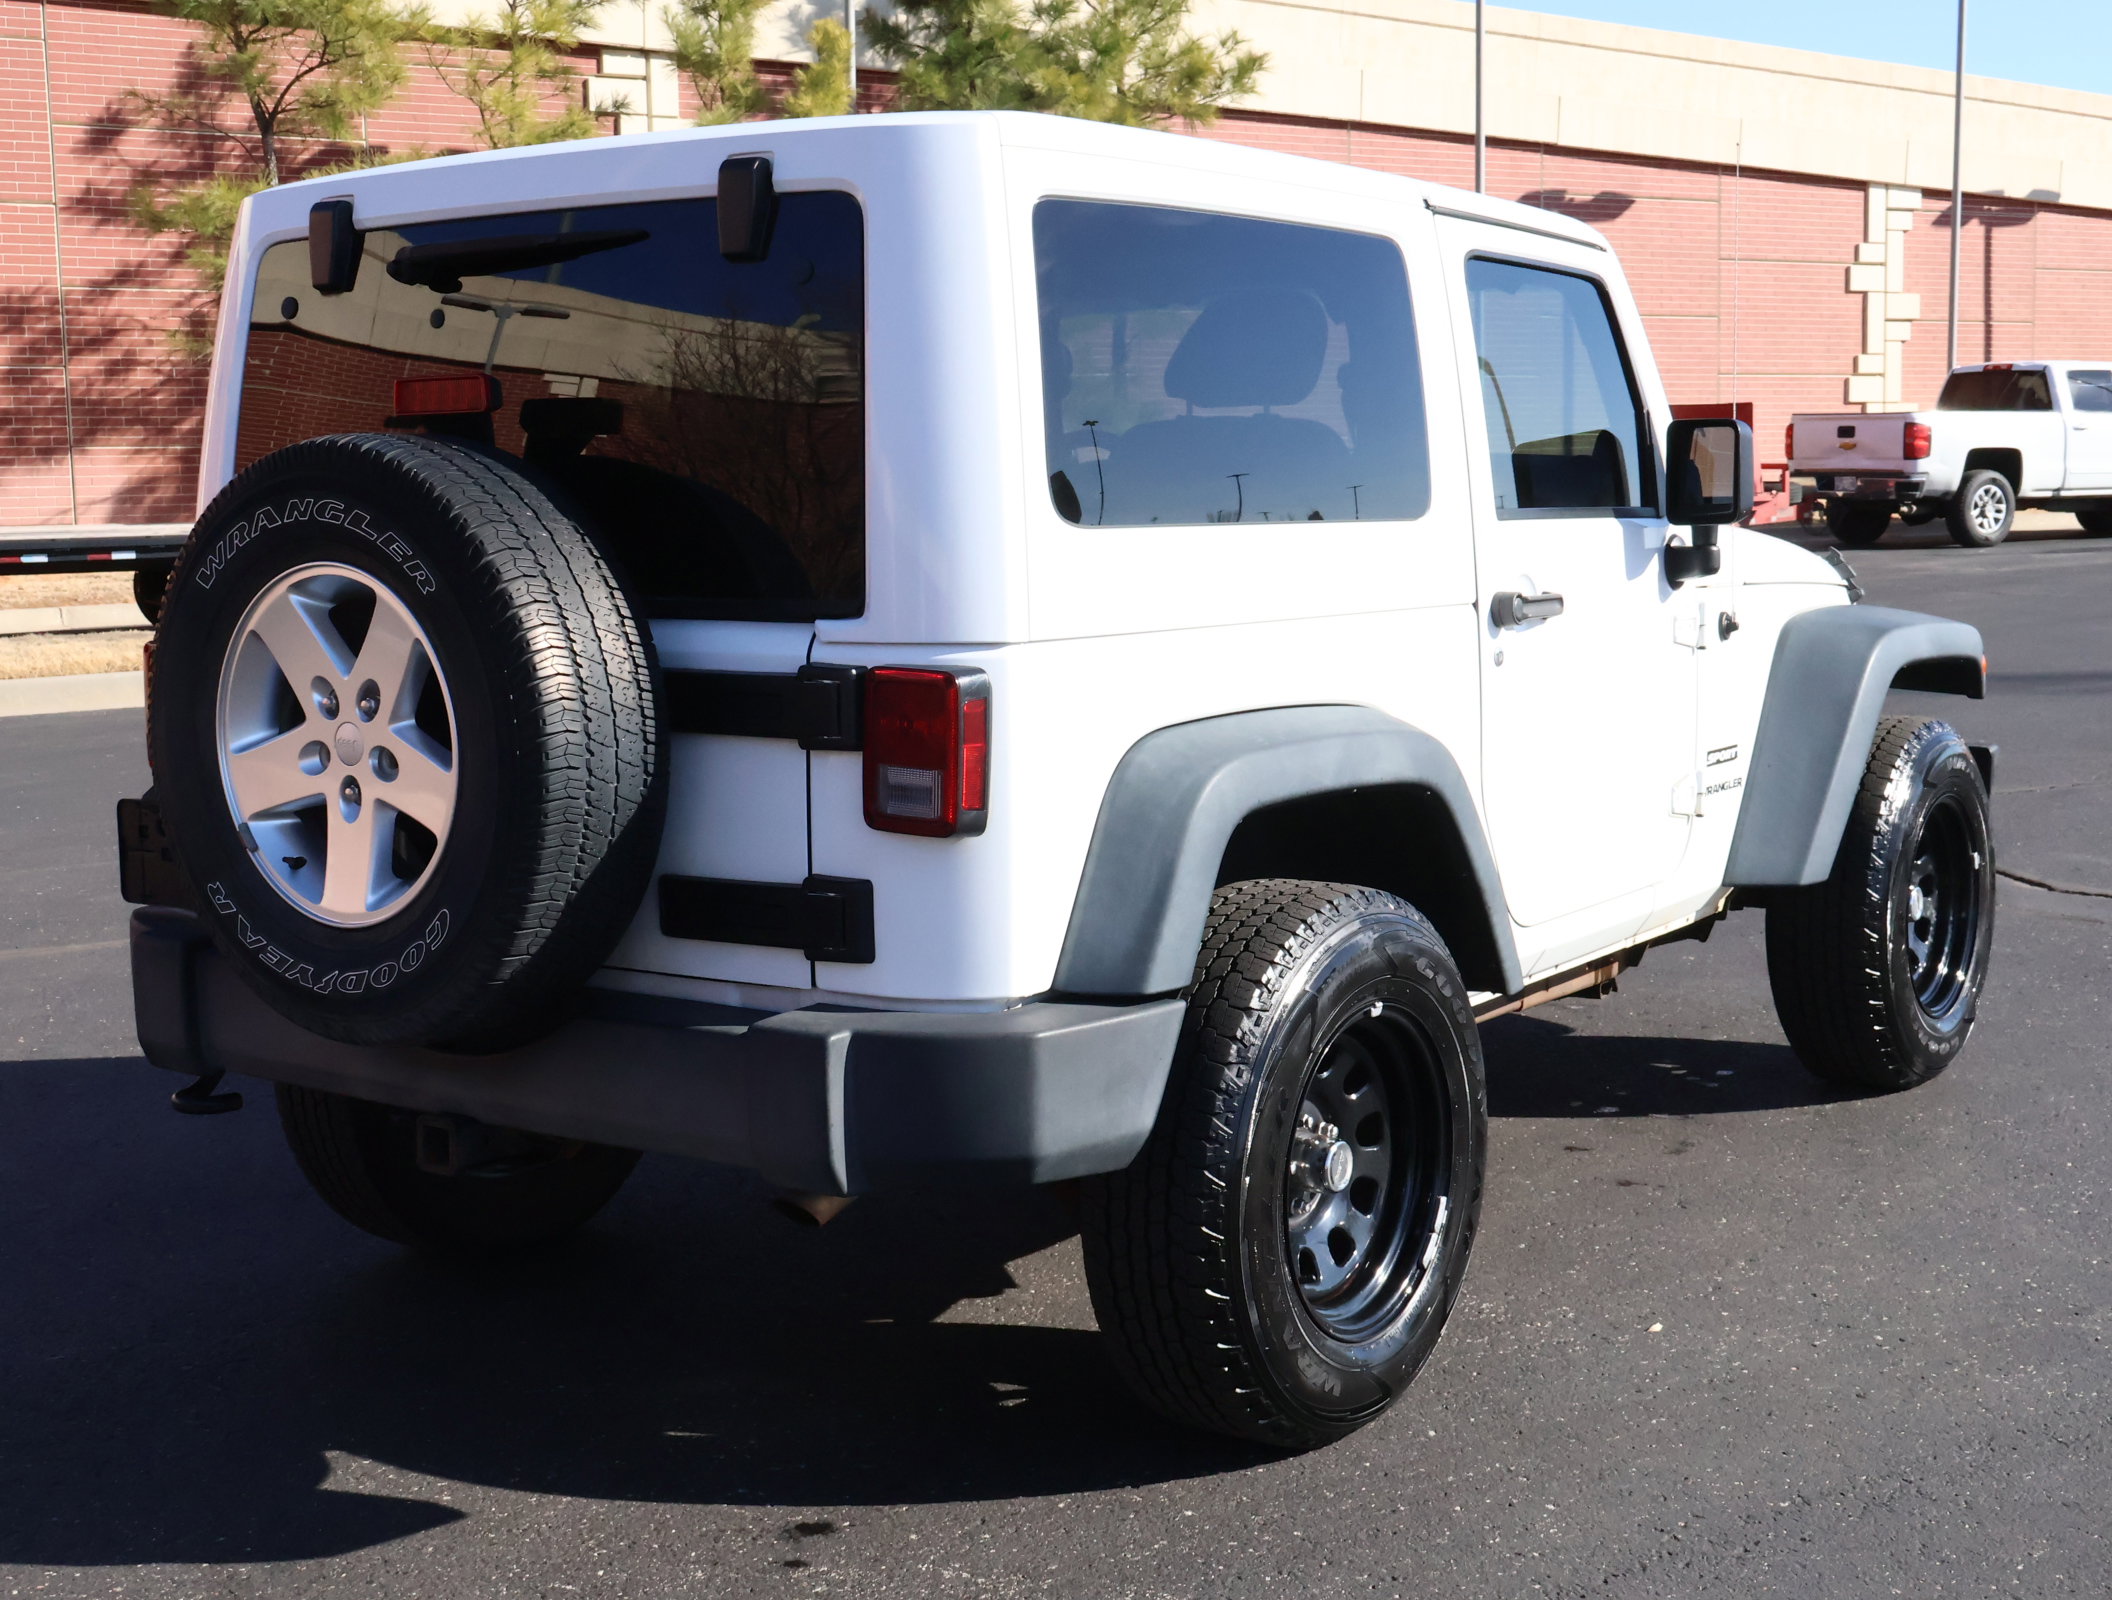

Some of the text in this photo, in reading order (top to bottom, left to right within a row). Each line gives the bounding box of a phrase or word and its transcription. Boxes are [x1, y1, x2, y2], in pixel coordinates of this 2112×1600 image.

[195, 498, 436, 596] WRANGLER
[1706, 744, 1738, 767] SPORT
[206, 881, 451, 995] GOODYEAR
